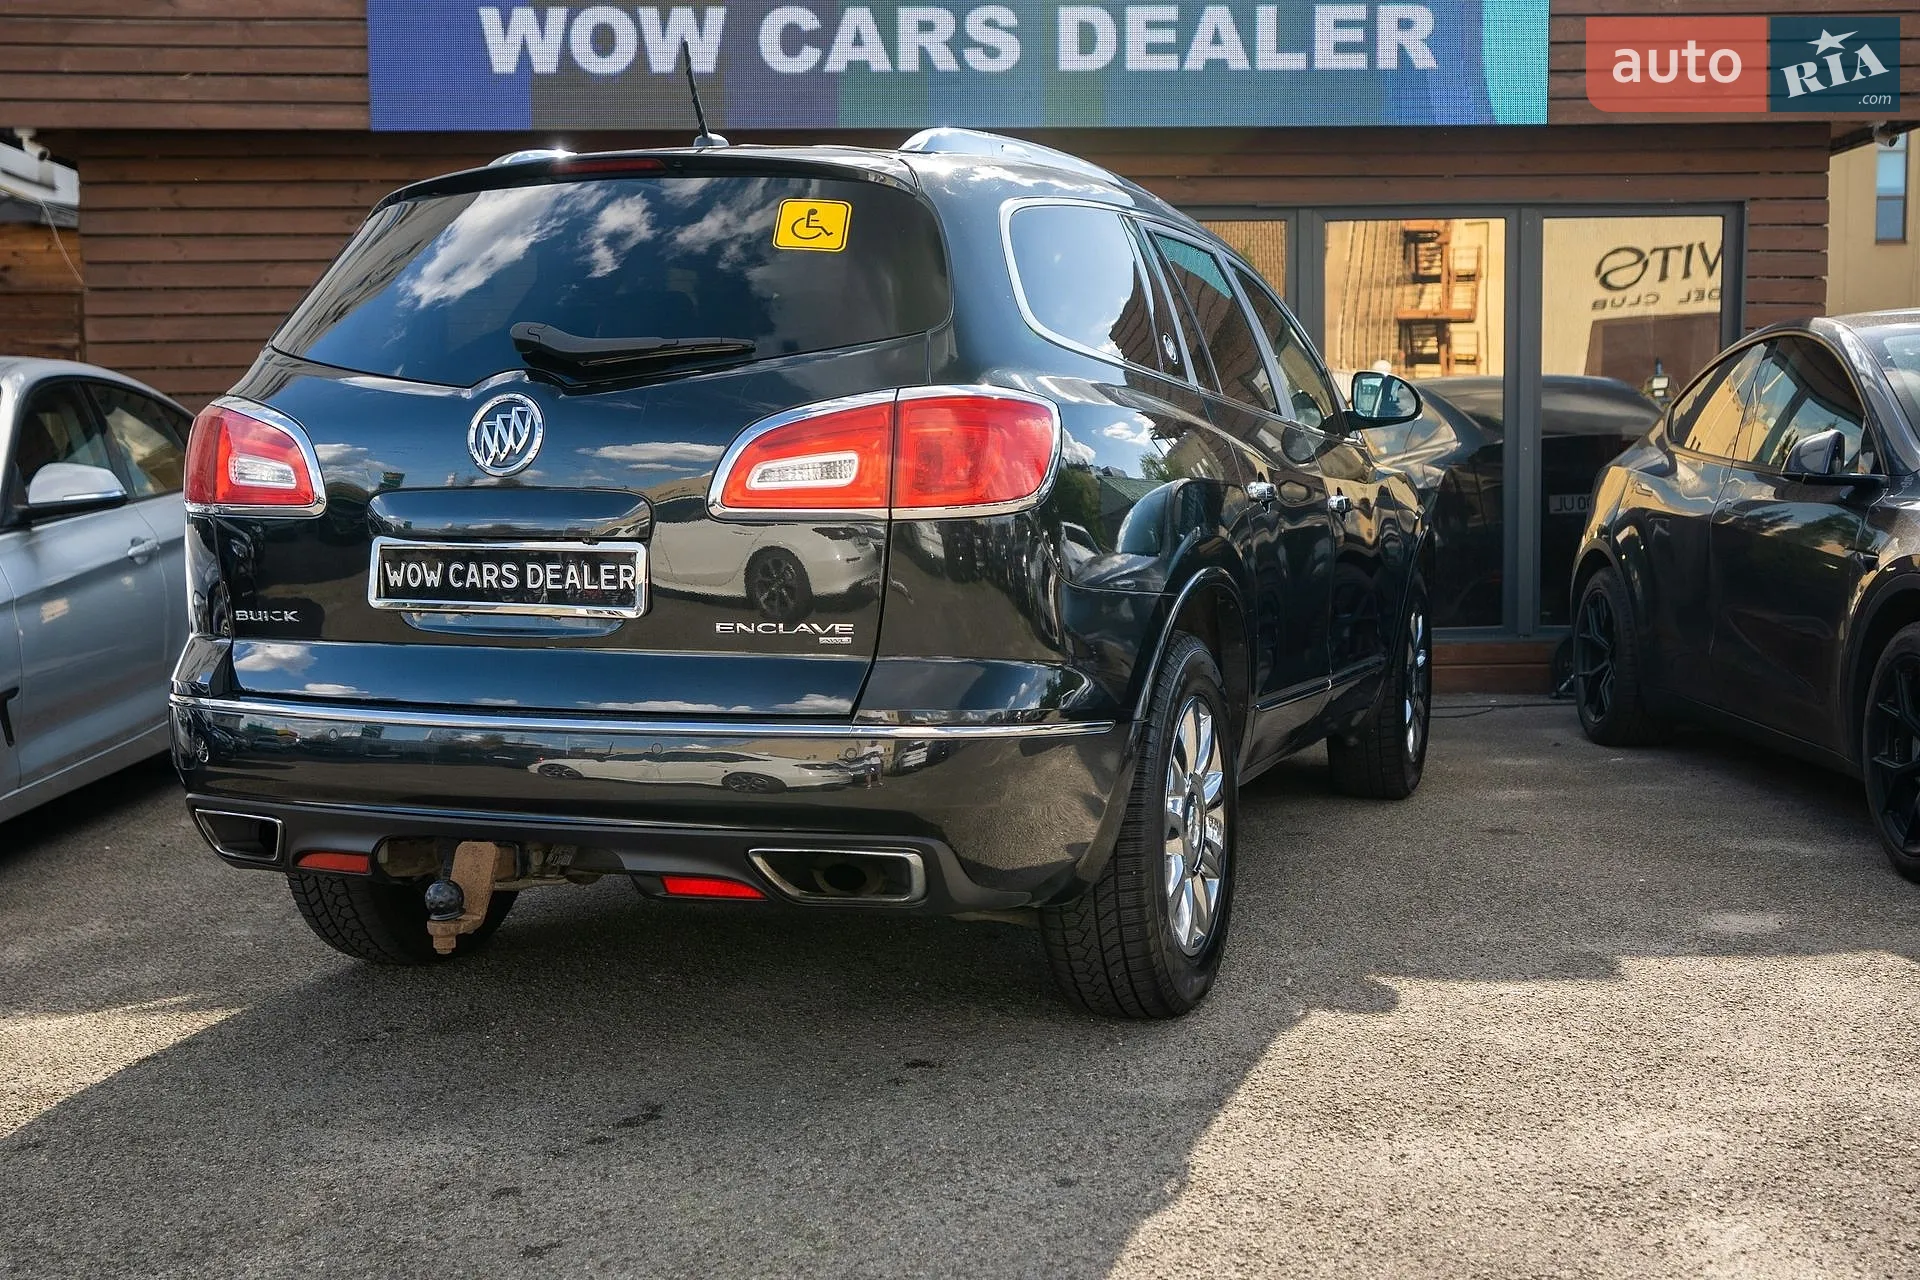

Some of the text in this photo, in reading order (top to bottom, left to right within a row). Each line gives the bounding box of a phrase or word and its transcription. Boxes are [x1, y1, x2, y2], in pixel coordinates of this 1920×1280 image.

[479, 4, 1439, 74] WOW CARS DEALER
[385, 562, 635, 590] WOW CARS DEALER
[235, 610, 300, 622] BUICK
[715, 622, 855, 635] ENCLAVE
